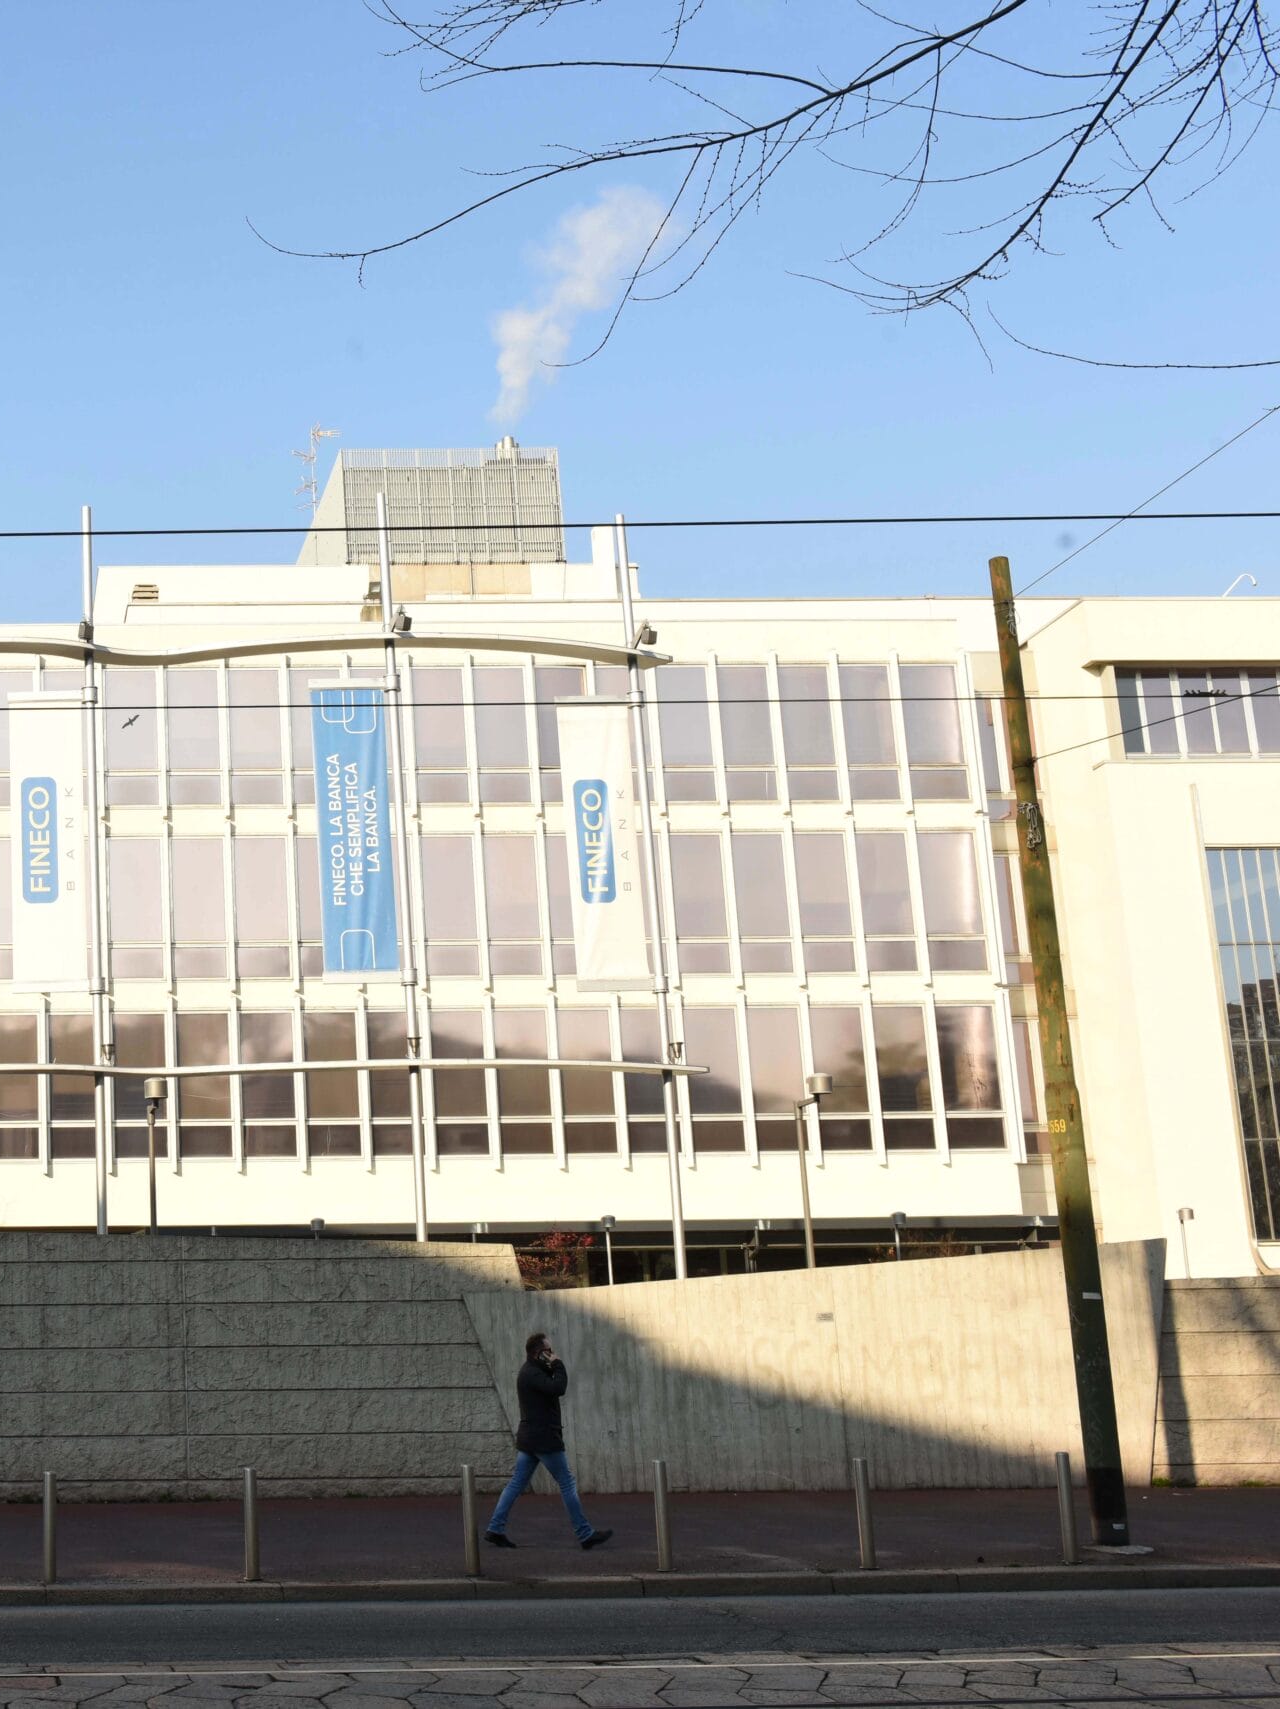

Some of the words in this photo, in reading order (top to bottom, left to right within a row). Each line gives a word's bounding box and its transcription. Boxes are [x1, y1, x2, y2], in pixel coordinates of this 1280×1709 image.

[327, 753, 341, 812] BANCA
[344, 762, 361, 858] SEMPLIFICA
[28, 786, 51, 893] FINECO
[64, 786, 75, 891] BANK
[329, 816, 342, 836] LA
[363, 785, 379, 850] BANCA.
[581, 788, 609, 894] FINECO
[616, 789, 632, 892] BANK
[330, 840, 347, 906] FINECO.
[348, 862, 364, 896] CHE
[367, 852, 380, 873] LA
